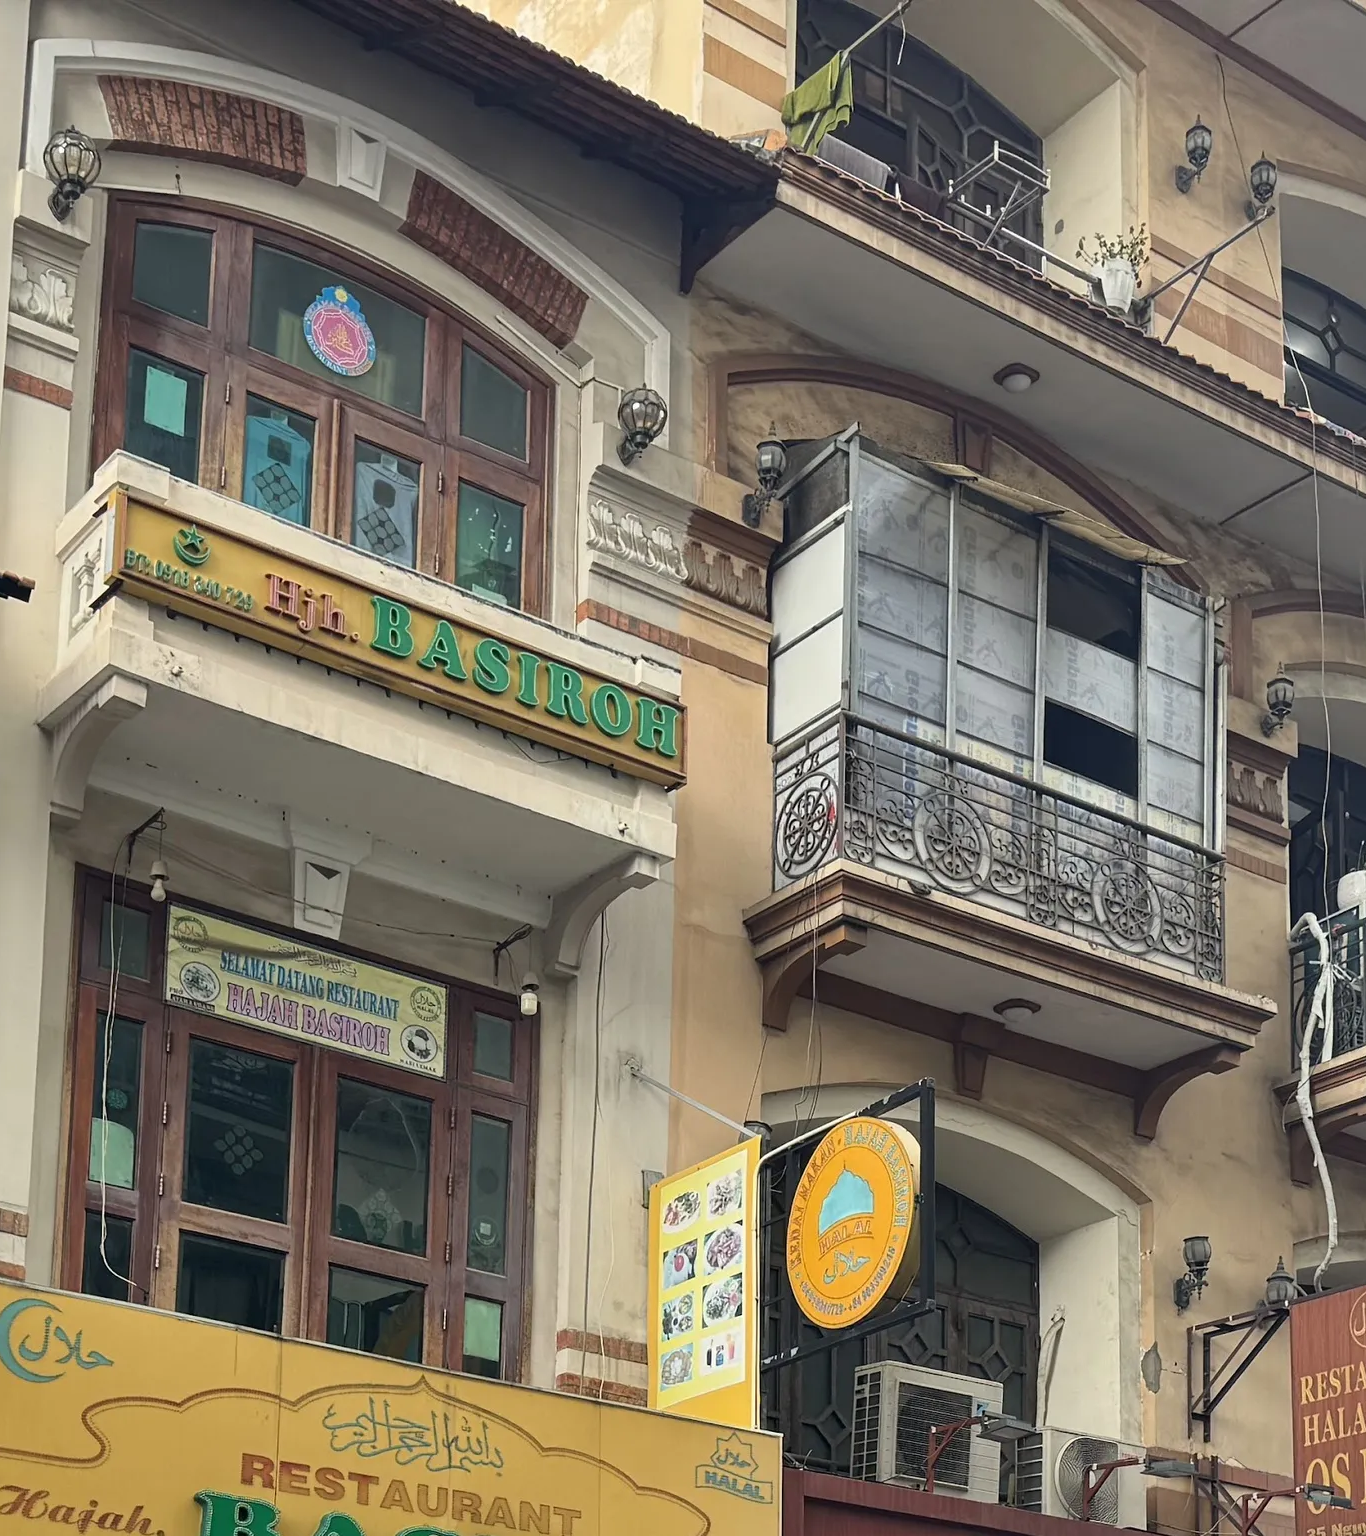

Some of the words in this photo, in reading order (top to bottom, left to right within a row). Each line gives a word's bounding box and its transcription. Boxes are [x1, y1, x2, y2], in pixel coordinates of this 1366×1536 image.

[154, 559, 190, 588] 0918
[194, 575, 222, 600] 340
[225, 587, 255, 613] 729
[264, 573, 360, 643] Hjh.
[370, 595, 678, 758] BASIROH
[220, 951, 276, 985] SELAMAT
[278, 965, 325, 999] DATANG
[327, 980, 399, 1021] RESTAURANT
[227, 983, 298, 1030] HAJAH
[302, 1005, 390, 1056] BASIROH
[705, 1471, 765, 1500] HALAL
